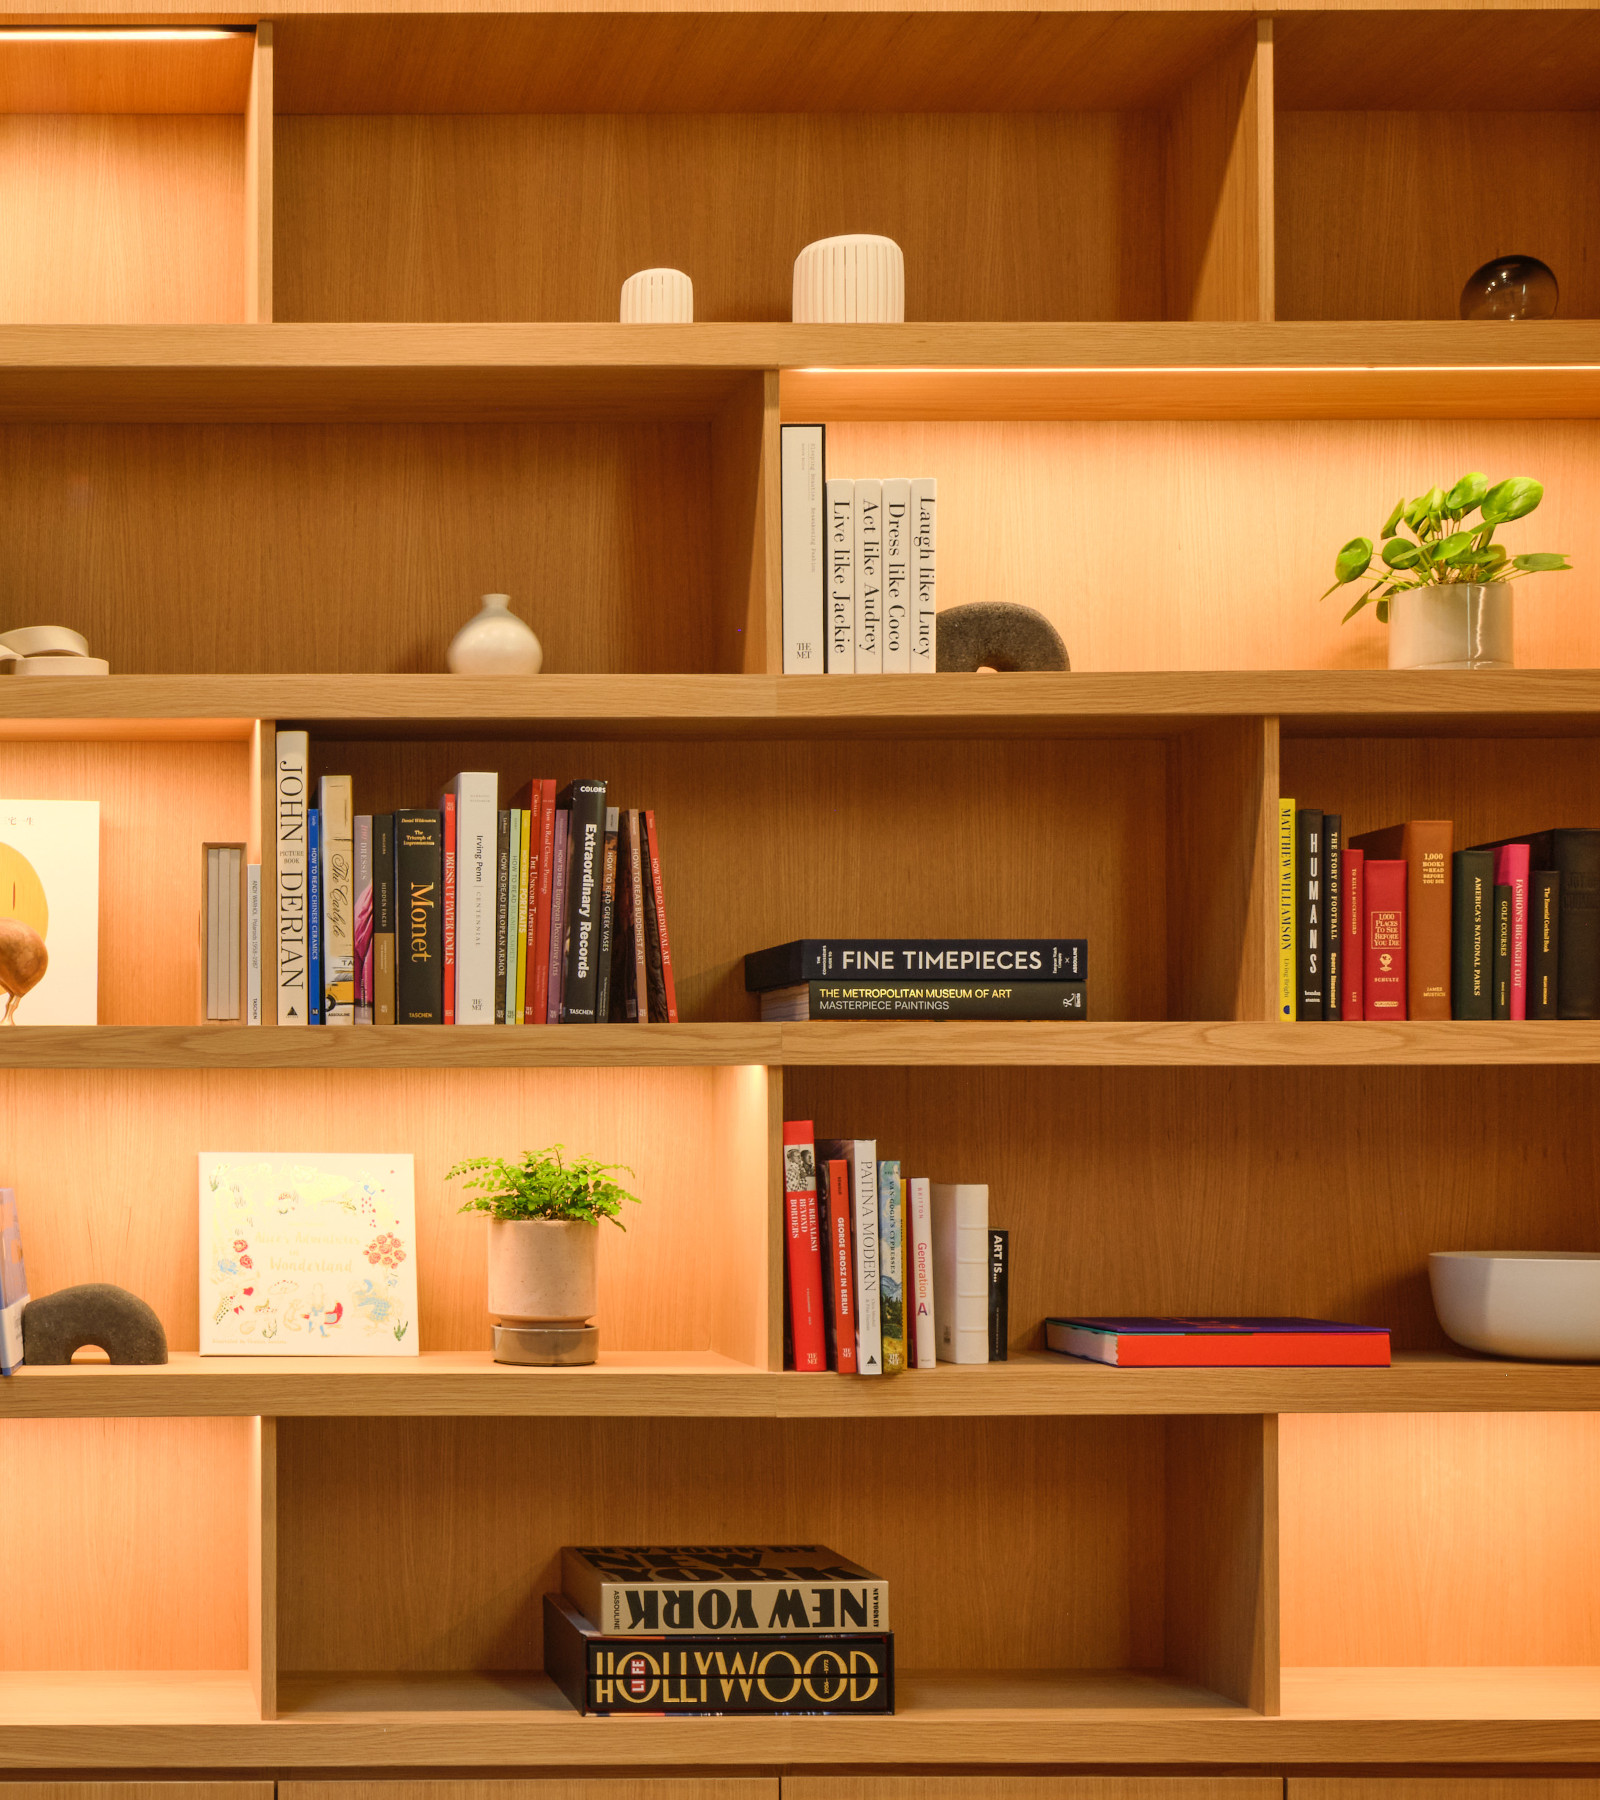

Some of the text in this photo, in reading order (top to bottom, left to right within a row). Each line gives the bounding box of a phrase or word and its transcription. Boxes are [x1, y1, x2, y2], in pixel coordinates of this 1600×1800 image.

[832, 500, 851, 653] Live like Jackie
[858, 498, 880, 655] Act like Audrey
[888, 501, 906, 652] Dress like Coco
[913, 496, 936, 659] Laugh like Lucy
[279, 760, 304, 842] JOHN
[580, 785, 607, 794] COLORS
[280, 850, 304, 858] PICTURE
[474, 835, 484, 883] Irving Penn
[1280, 808, 1292, 951] MATTHEW WILLIAMSON
[327, 854, 350, 938] The Carlyle
[445, 852, 455, 966] DRESS UP PAPER DOLLS
[577, 823, 598, 979] Extraordinary Records
[1308, 833, 1319, 974] HUMANS
[1330, 832, 1338, 940] THE STORY OF FOOTBALL
[280, 872, 304, 990] DERIAN
[411, 881, 435, 963] Monet
[475, 891, 483, 947] CENTENNIAL
[1473, 877, 1482, 996] AMERICA'S NATIONAL PARKS
[1513, 879, 1524, 988] FASHION'S BIG NIGHT OUT
[842, 951, 894, 970] FINE
[902, 950, 1042, 970] TIMEPIECES
[569, 1008, 594, 1016] TASCHEN
[820, 988, 1012, 998] THE METROPOLITAN MUSEUM OF ART
[820, 1000, 950, 1010] MASTERPIECE PAINTINGS
[790, 1199, 799, 1238] BORDERS
[799, 1198, 808, 1233] BEYOND
[861, 1160, 874, 1217] PATINA
[808, 1197, 818, 1252] SURREALISM
[840, 1278, 847, 1287] IN
[862, 1222, 878, 1292] MODERN
[917, 1242, 928, 1316] Generation A
[993, 1234, 1003, 1283] ART IS...
[841, 1288, 849, 1315] BERLIN
[625, 1588, 868, 1630] NEW YORK
[596, 1650, 879, 1703] HOLLYWOOD
